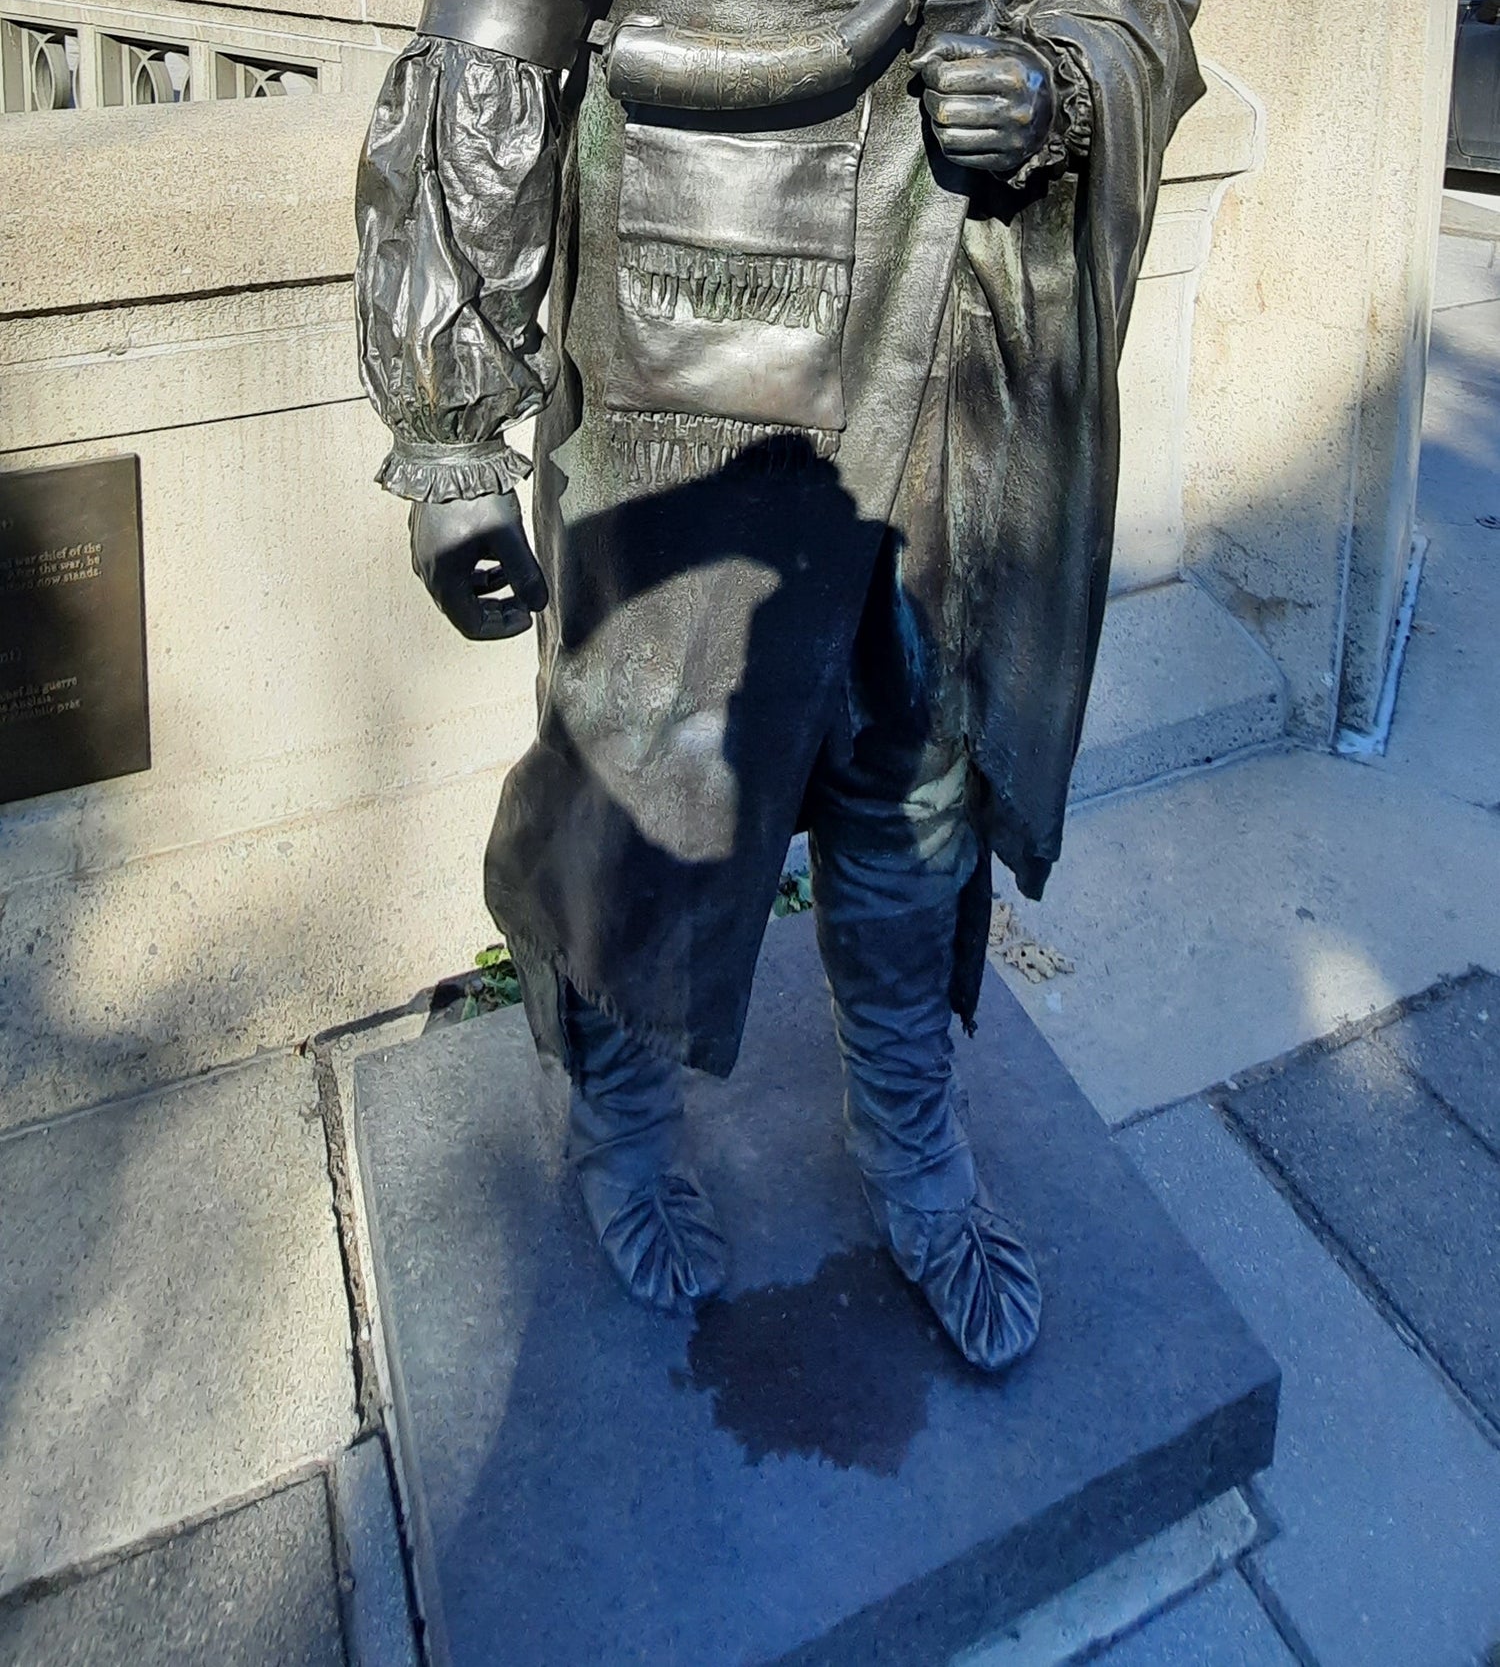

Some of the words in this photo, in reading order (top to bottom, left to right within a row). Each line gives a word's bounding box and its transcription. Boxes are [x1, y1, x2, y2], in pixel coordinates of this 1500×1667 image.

[39, 547, 68, 562] chief
[69, 543, 82, 557] of
[84, 542, 102, 554] the
[39, 561, 58, 575] the
[60, 559, 84, 571] war,
[87, 554, 101, 567] he
[37, 574, 61, 589] now
